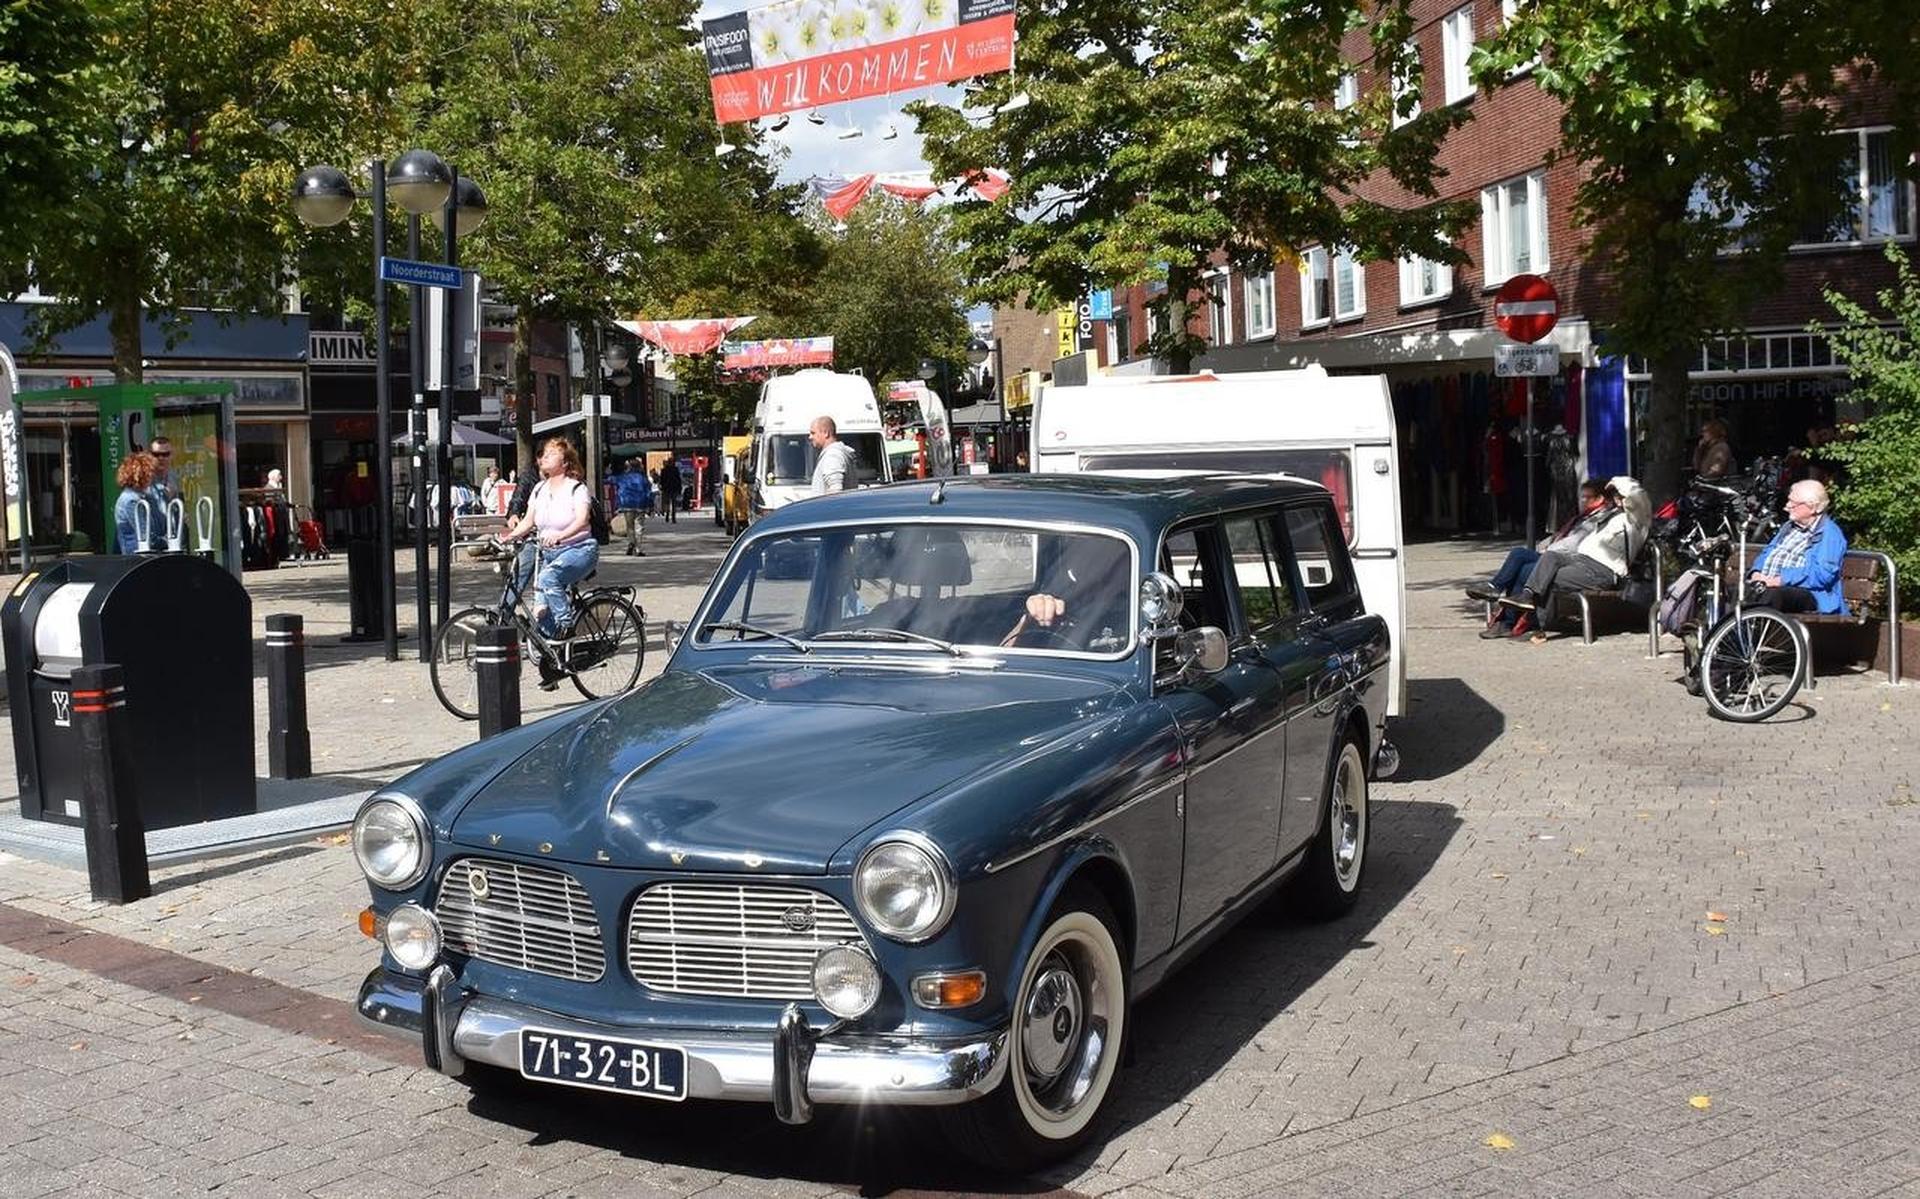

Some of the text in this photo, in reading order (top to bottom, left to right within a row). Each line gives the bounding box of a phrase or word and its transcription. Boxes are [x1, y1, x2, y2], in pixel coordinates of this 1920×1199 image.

[757, 36, 957, 112] WILLKOMMEN
[390, 263, 455, 281] Noorderstraat
[1080, 303, 1092, 338] FOTO
[488, 833, 763, 867] VOLVO
[528, 1035, 676, 1092] 71-32-BL
